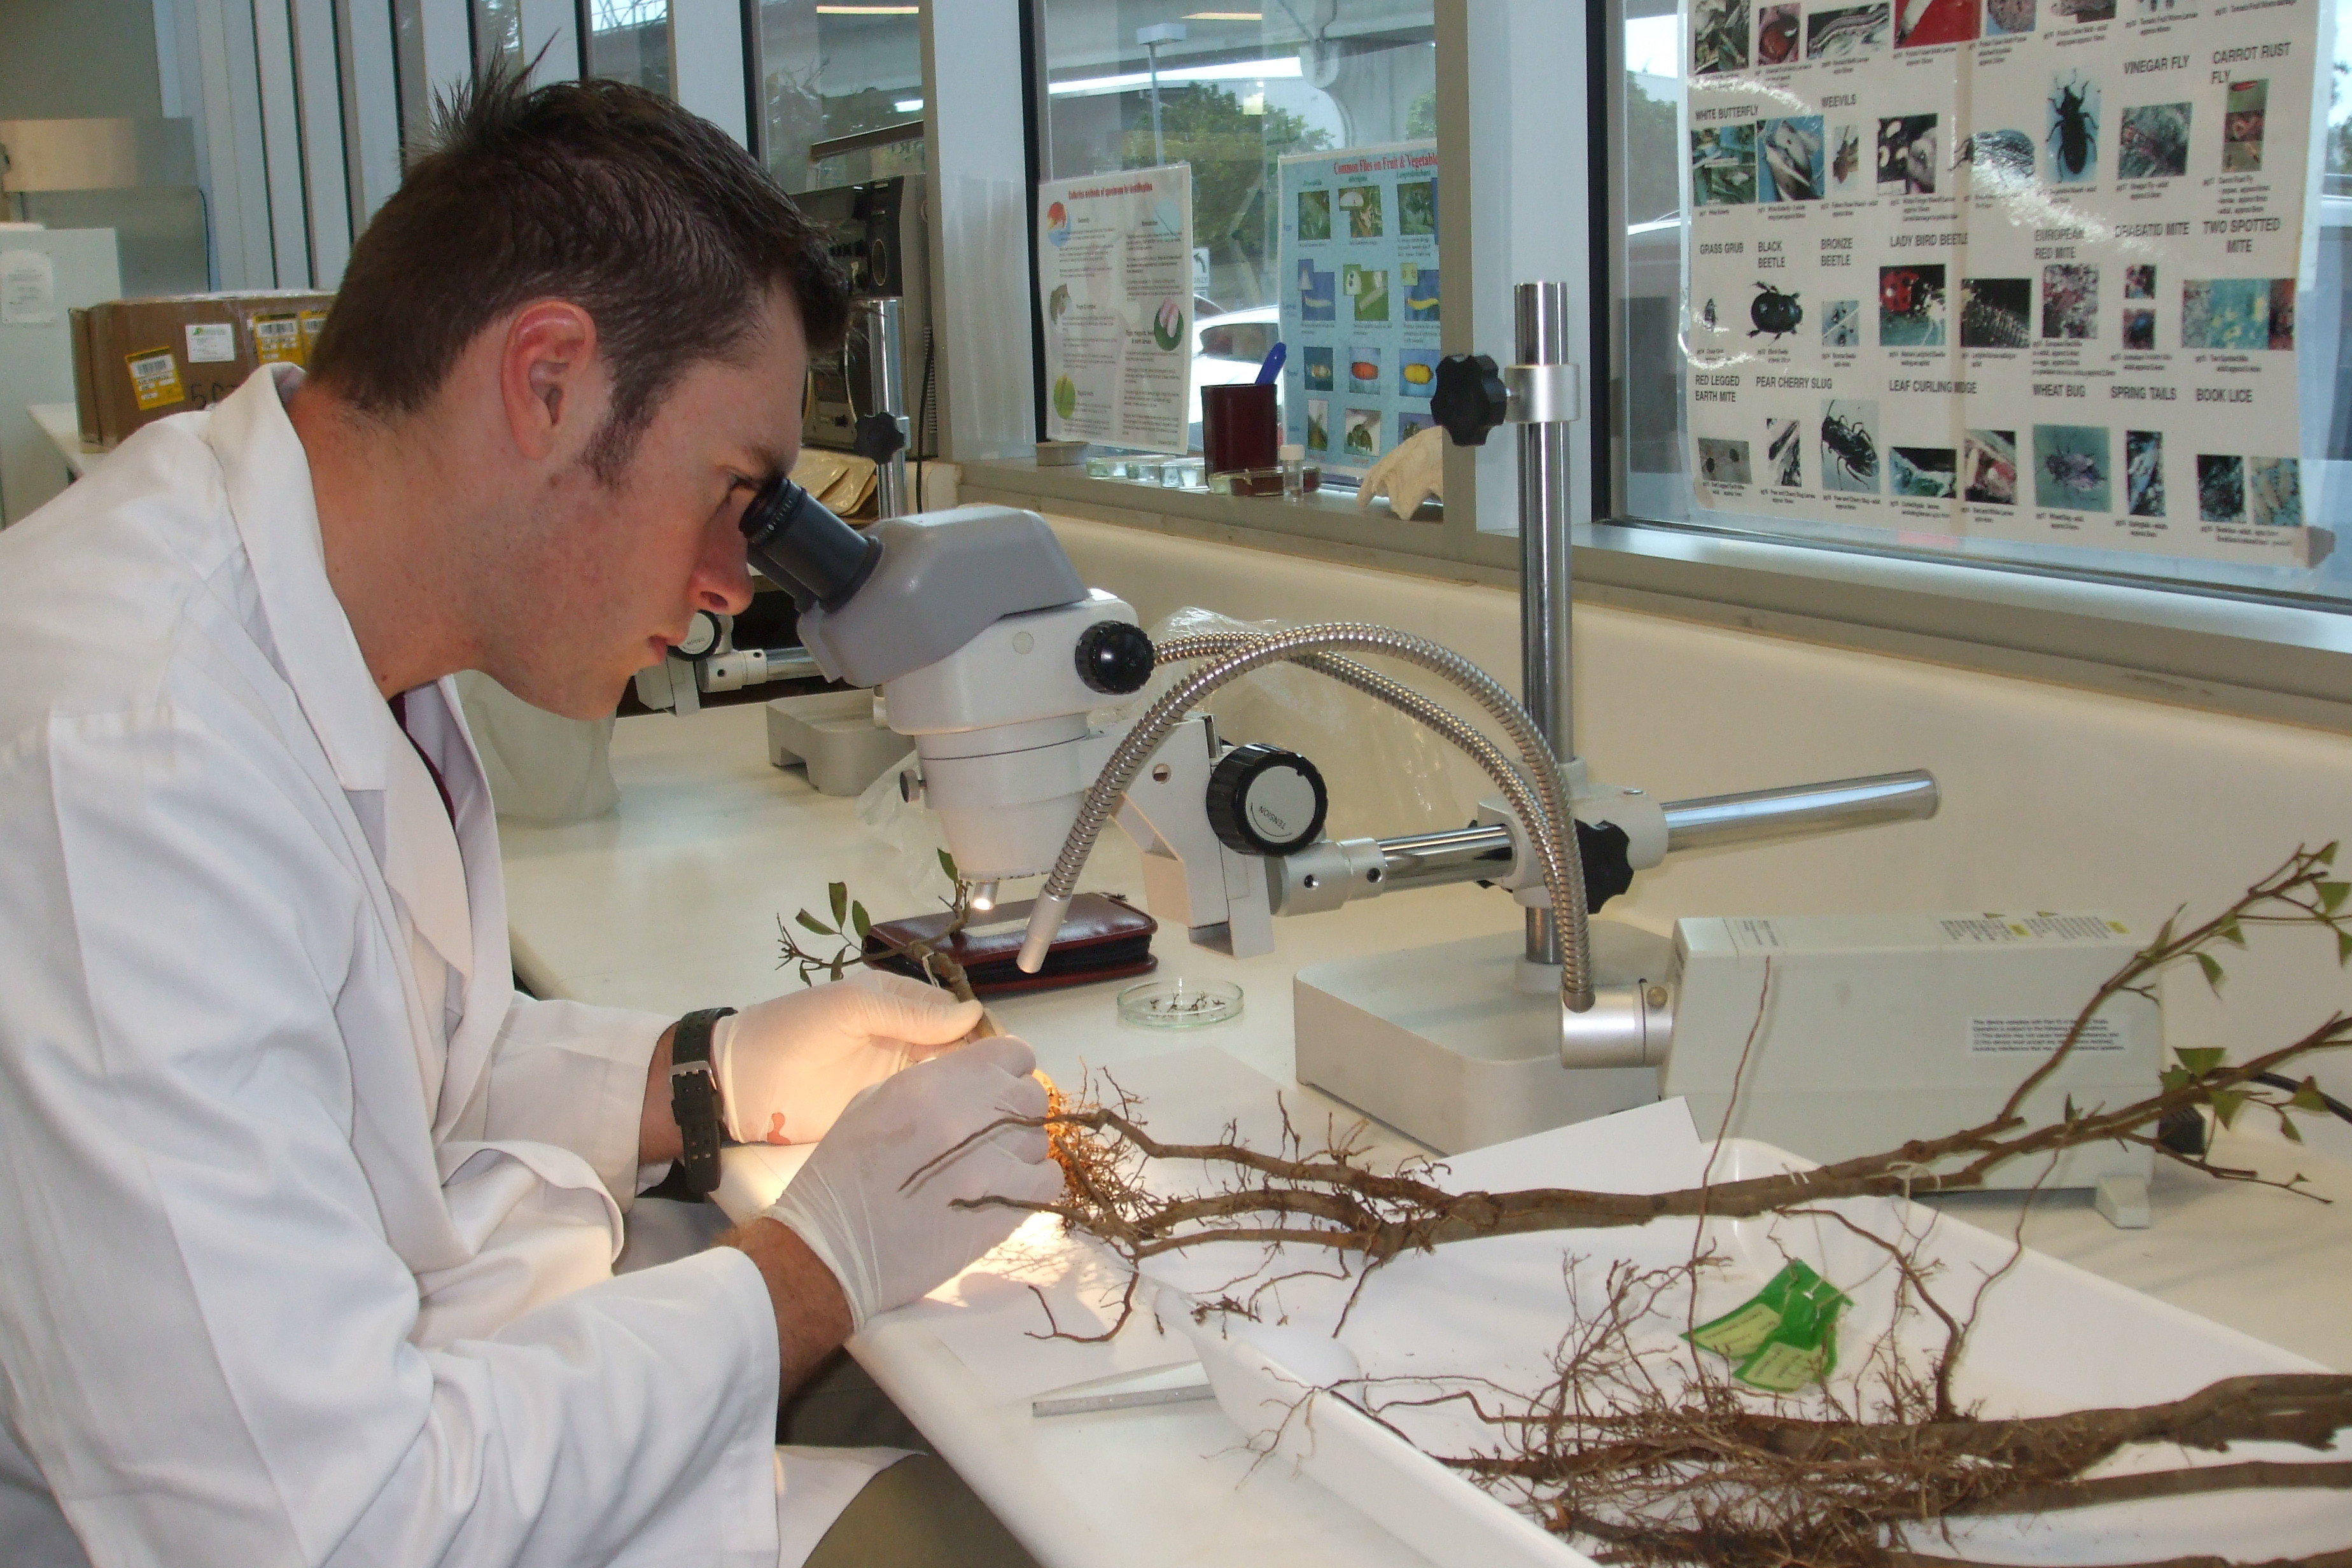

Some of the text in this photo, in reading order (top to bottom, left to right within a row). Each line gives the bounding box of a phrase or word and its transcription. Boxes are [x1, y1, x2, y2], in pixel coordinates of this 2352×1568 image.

[2213, 42, 2292, 64] CARROT RUST
[2124, 55, 2190, 74] VINEGAR FLY
[2211, 70, 2230, 84] FLY
[1821, 94, 1856, 108] WEEVILS
[1695, 105, 1759, 121] WHITE BUTTERFLY
[2166, 221, 2190, 235] MITE
[2203, 218, 2281, 234] TWO SPOTTED
[1890, 233, 1968, 248] LADY BIRD BEETLE
[2034, 228, 2085, 241] EUROPEAN
[1700, 242, 1744, 255] GRASS GRUB
[1758, 241, 1782, 253] BLACK
[1821, 237, 1853, 250] BRONZE
[2227, 239, 2253, 253] MITE
[2034, 246, 2076, 260] RED MITE
[1758, 256, 1785, 269] BEETLE
[1821, 255, 1851, 267] BEETLE
[1695, 375, 1740, 386] RED LEGGED
[1756, 376, 1833, 389] PEAR CHERRY SLUG
[1889, 380, 1910, 391] LEAF
[1913, 381, 1952, 392] CURLING
[1695, 390, 1736, 402] EARTH MITE
[2033, 383, 2086, 397] WHEAT BUG
[2111, 386, 2177, 400] SPRING TAILS
[2196, 388, 2253, 403] BOOK LICE
[1259, 806, 1286, 830] TENSION
